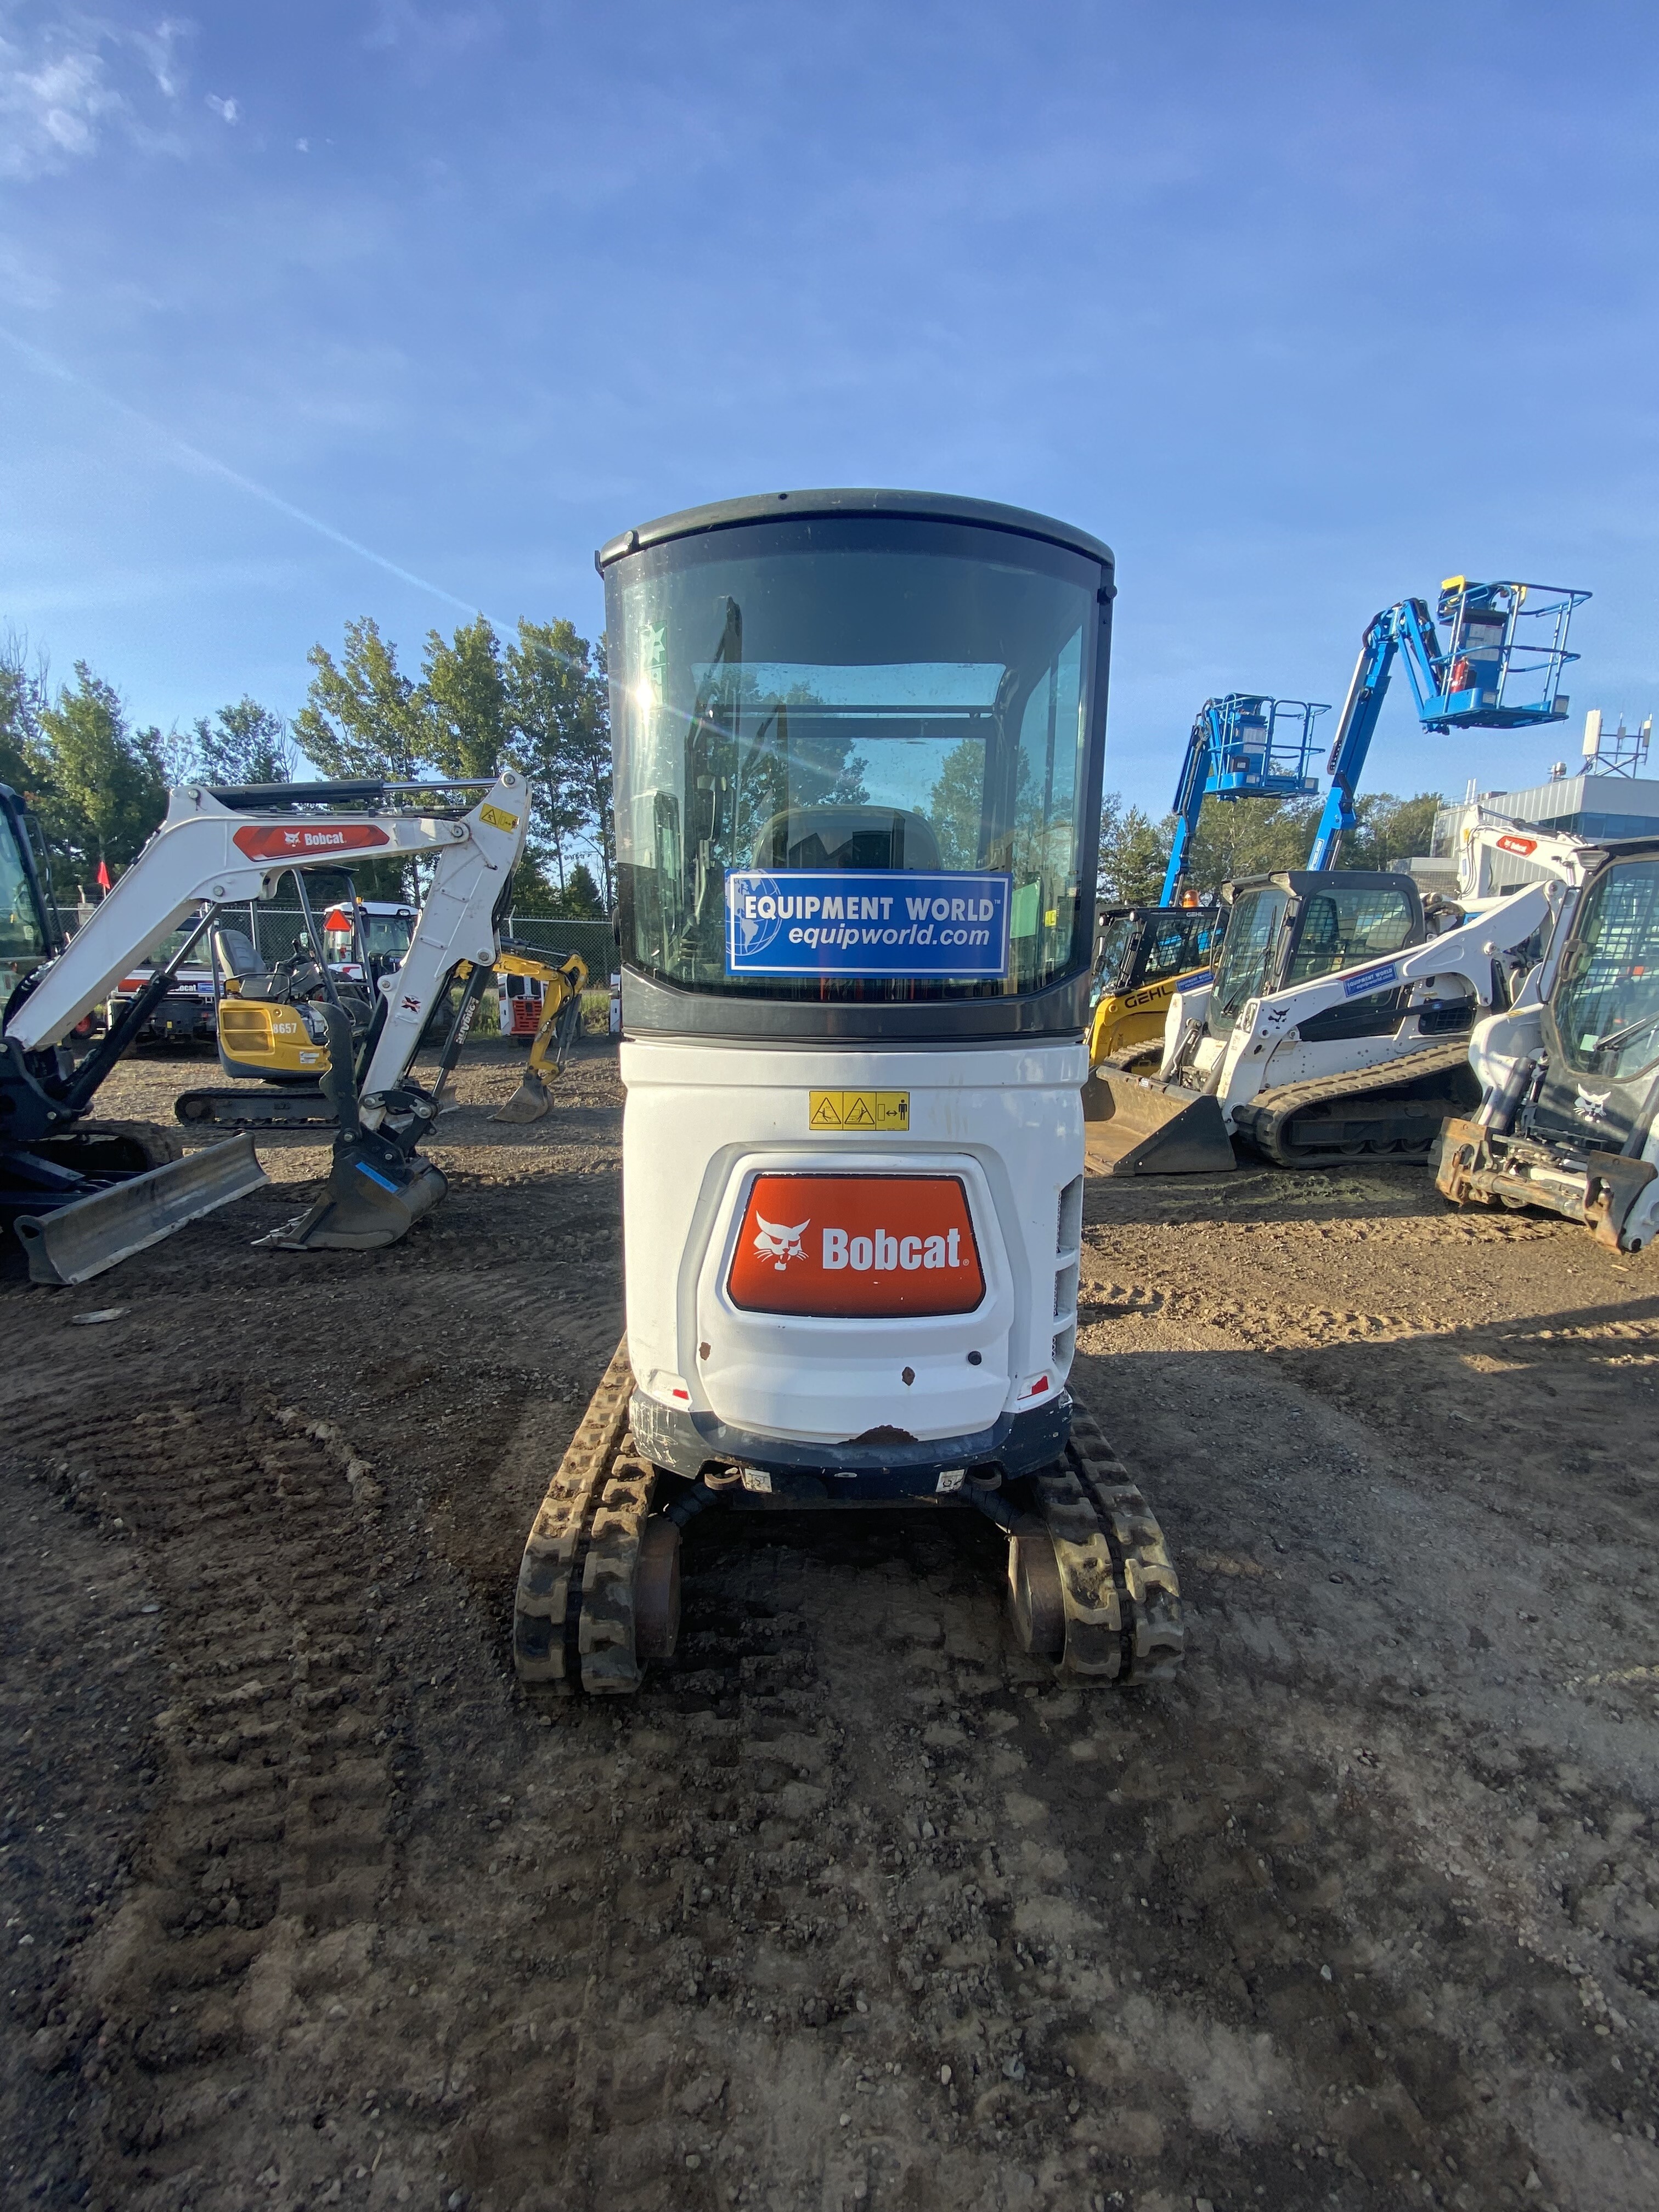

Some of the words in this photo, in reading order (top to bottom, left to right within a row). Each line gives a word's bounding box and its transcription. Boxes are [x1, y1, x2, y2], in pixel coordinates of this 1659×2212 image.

[304, 832, 345, 846] Bobcat
[744, 895, 893, 920] EQUIPMENT
[905, 897, 994, 922] WORLD
[788, 923, 989, 950] equipworld.com
[1125, 985, 1173, 1008] GEHL
[273, 1023, 297, 1034] 8657
[822, 1228, 961, 1271] Bobcat
